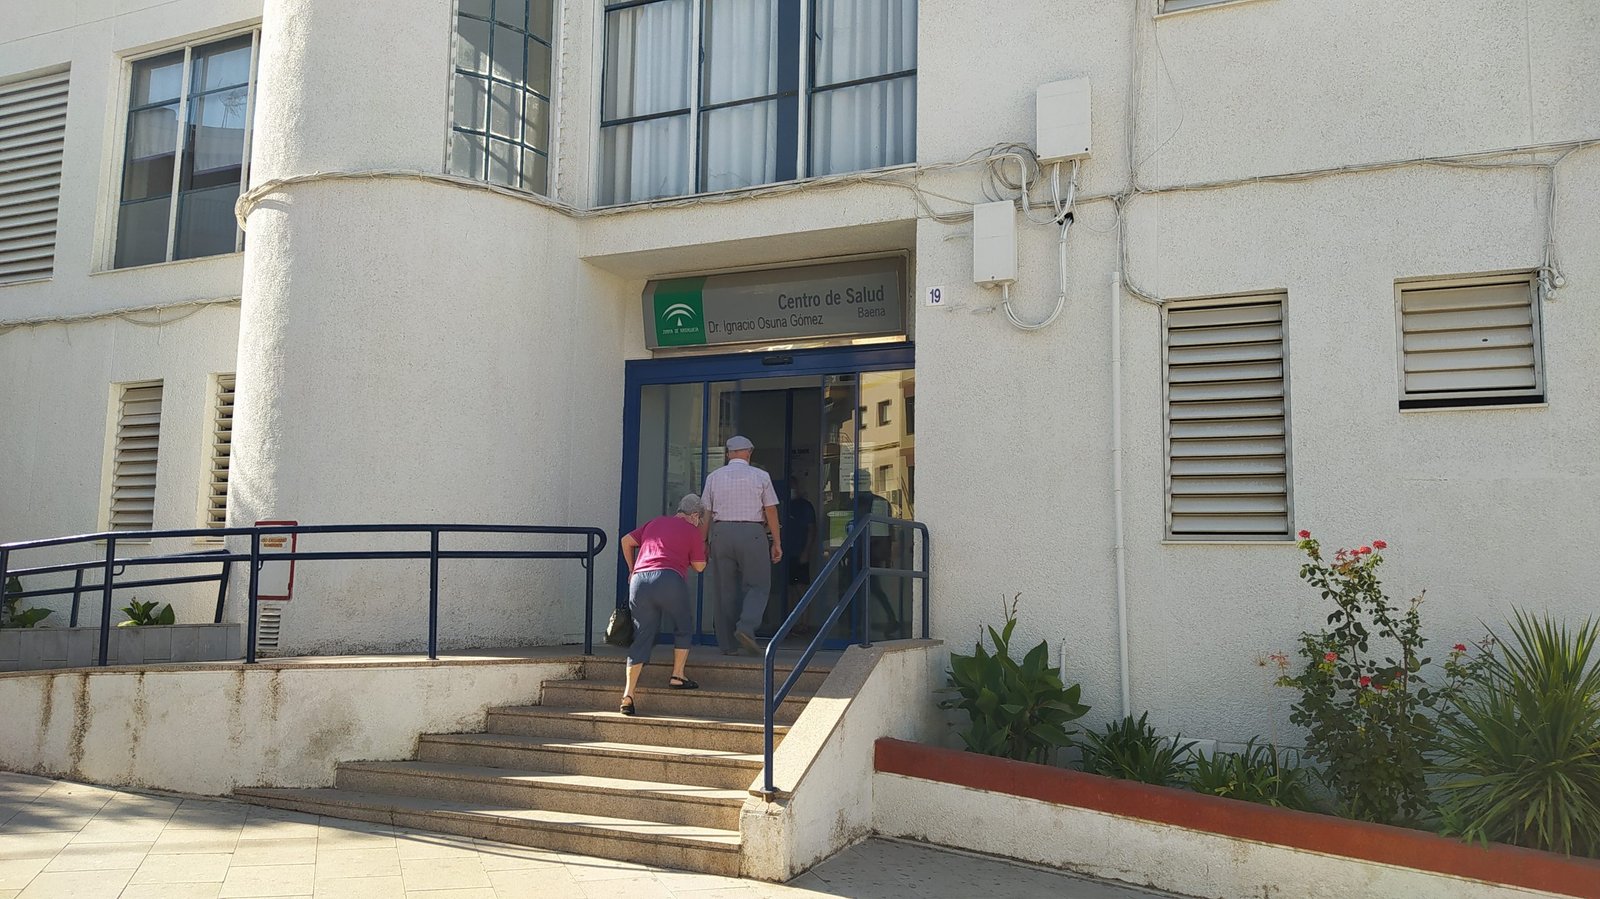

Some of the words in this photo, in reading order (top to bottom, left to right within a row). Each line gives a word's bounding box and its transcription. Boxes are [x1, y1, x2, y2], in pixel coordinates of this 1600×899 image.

[778, 293, 821, 310] Centro
[825, 290, 841, 306] de
[846, 285, 884, 304] Salud
[929, 288, 941, 304] 19
[857, 306, 886, 318] Baena
[708, 320, 721, 334] Dr.
[723, 319, 755, 335] Ignacio
[757, 316, 788, 330] Osuna
[790, 313, 824, 327] Gómez
